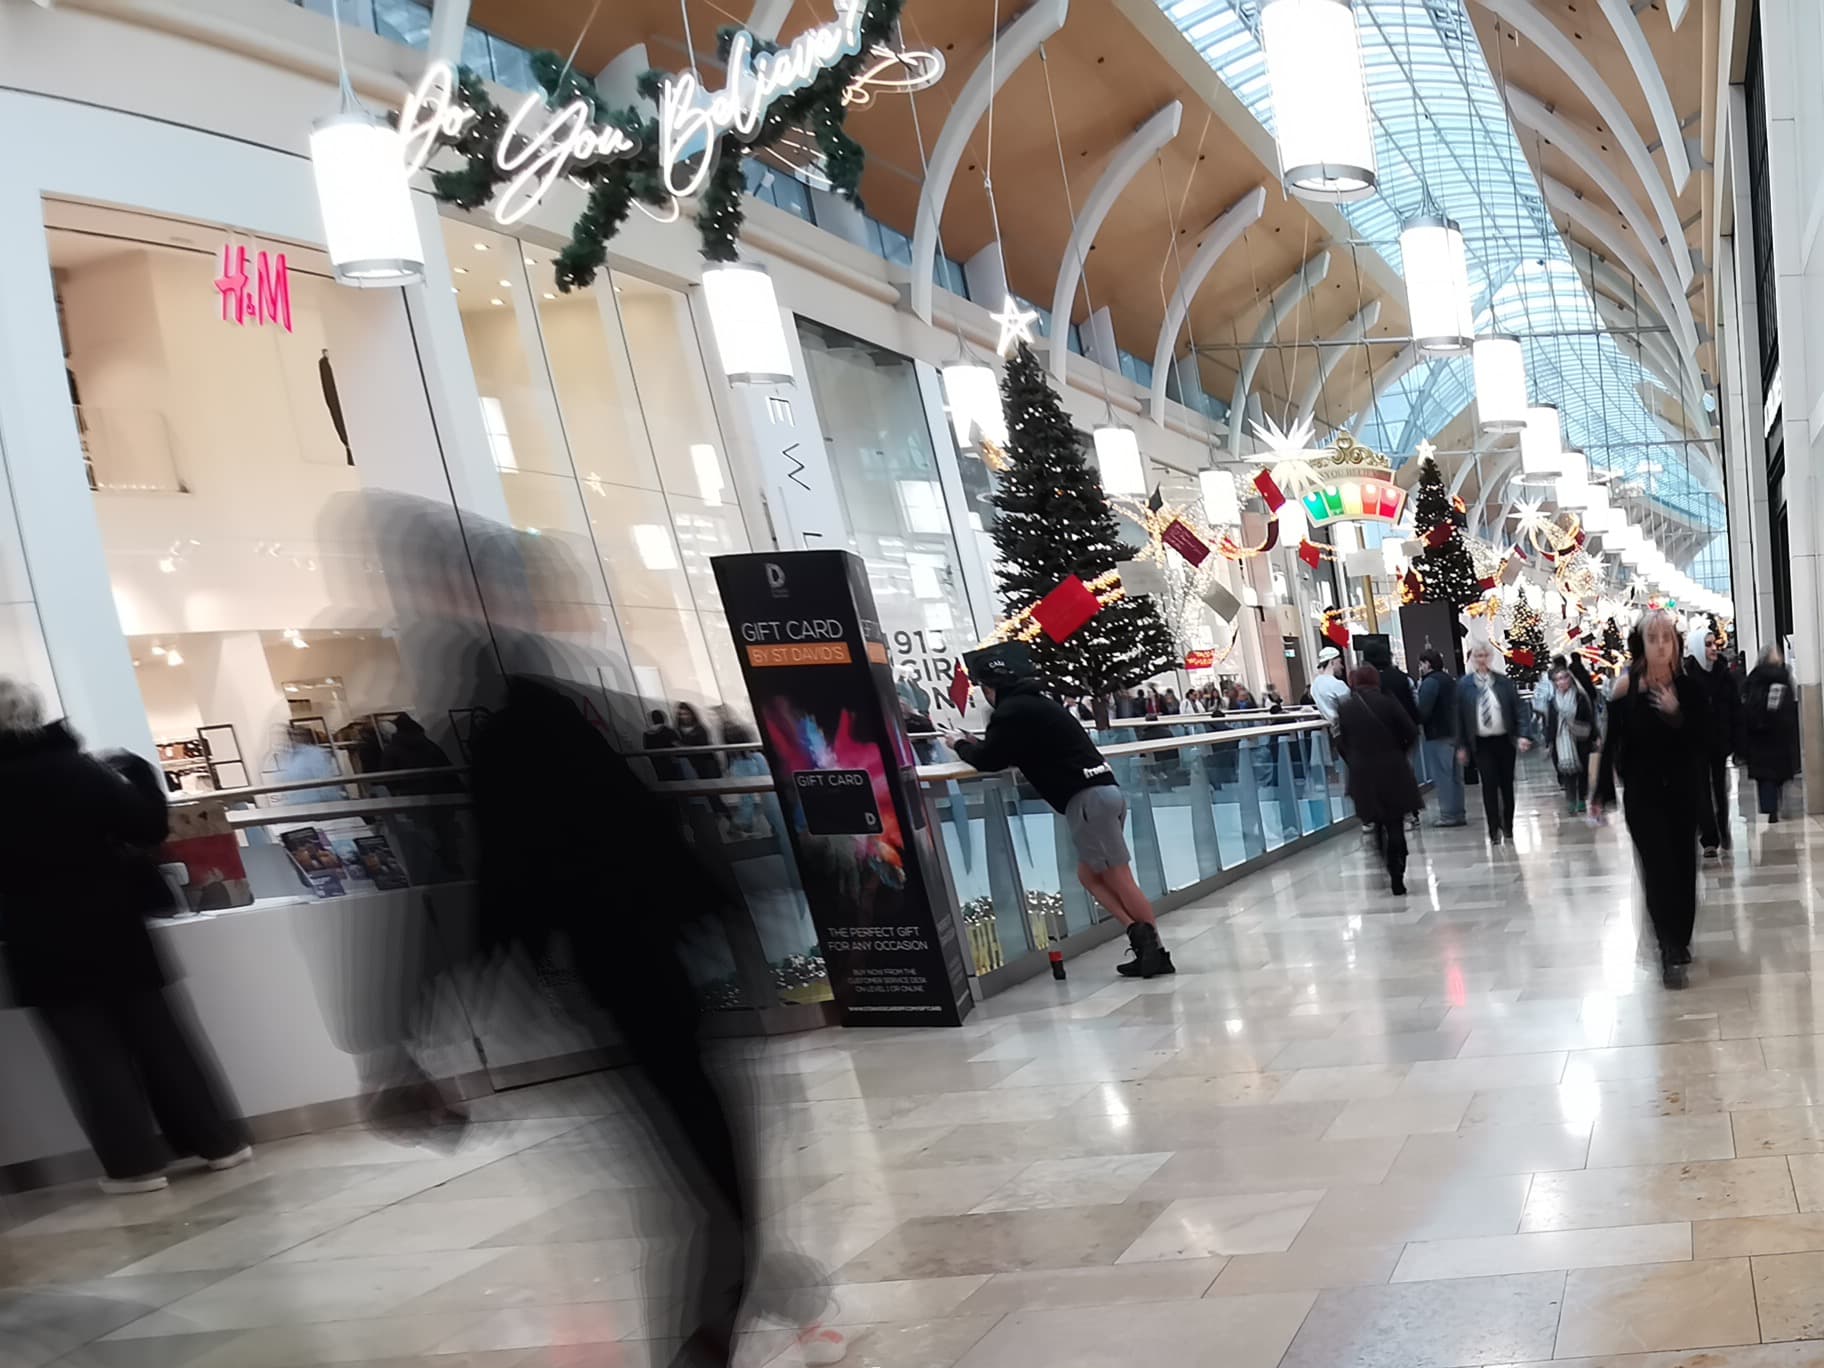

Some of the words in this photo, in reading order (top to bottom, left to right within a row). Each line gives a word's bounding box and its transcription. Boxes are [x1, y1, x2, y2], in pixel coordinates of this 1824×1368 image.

[495, 93, 634, 225] You
[214, 243, 292, 332] H&M
[741, 621, 781, 642] GIFT
[786, 619, 843, 640] CARD
[752, 649, 769, 663] BY
[773, 648, 788, 662] ST
[792, 646, 845, 661] DAVID'S
[797, 775, 823, 787] GIFT
[828, 774, 864, 786] CARD
[828, 927, 849, 937] THE
[850, 926, 895, 937] PERFECT
[896, 926, 920, 937] GIFT
[828, 941, 850, 951] FOR
[852, 941, 873, 951] ANY
[873, 940, 929, 951] OCCASION
